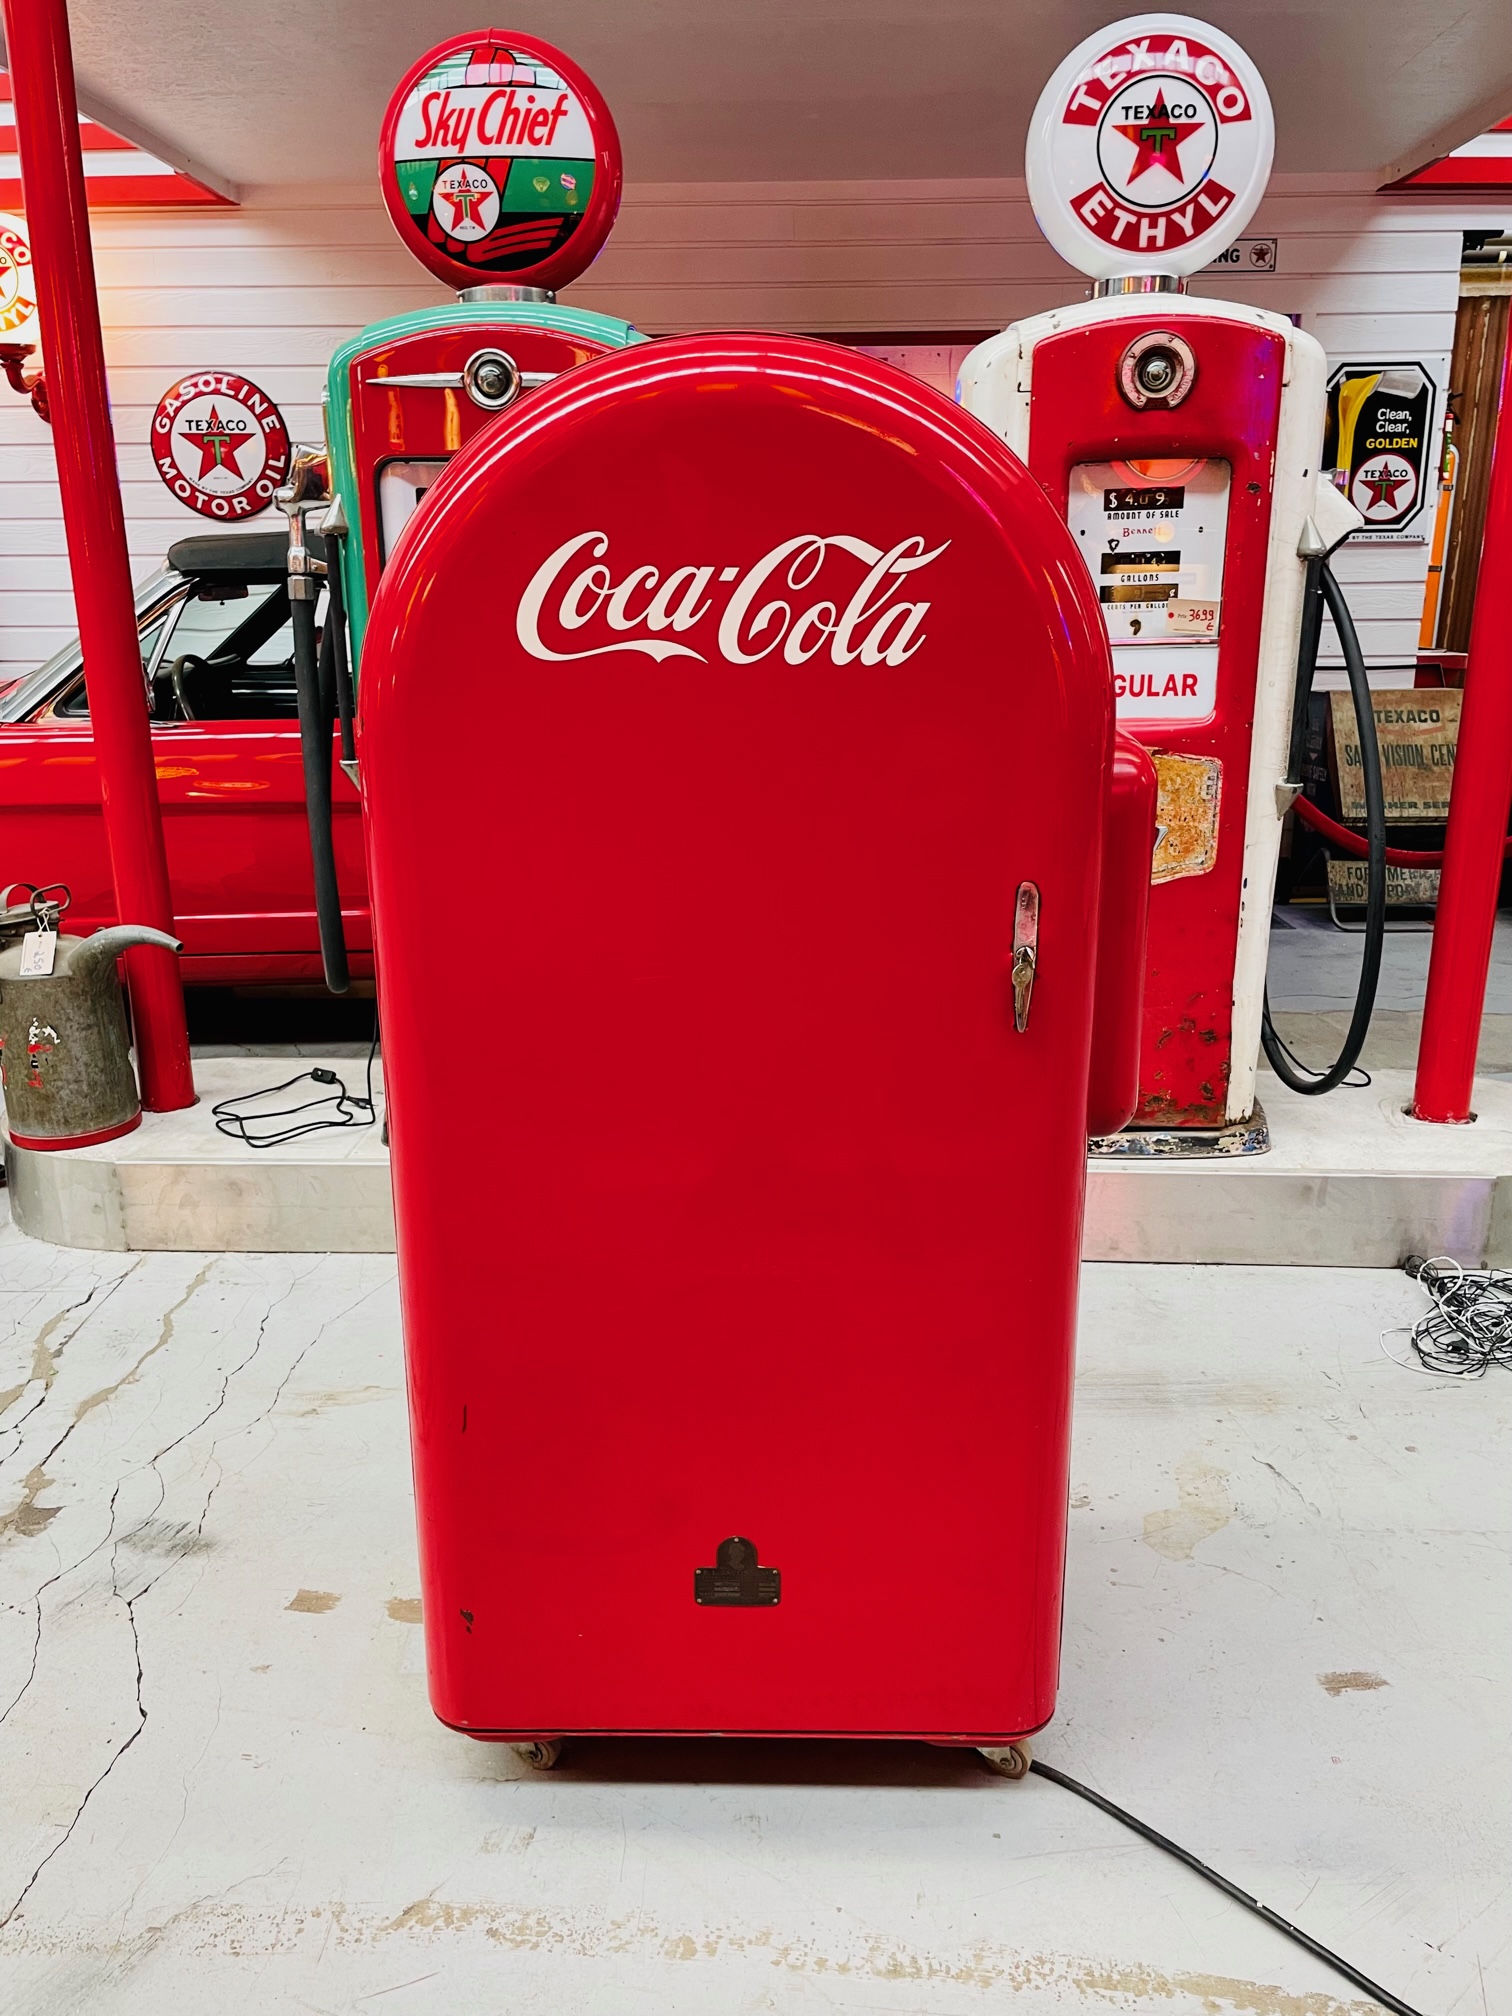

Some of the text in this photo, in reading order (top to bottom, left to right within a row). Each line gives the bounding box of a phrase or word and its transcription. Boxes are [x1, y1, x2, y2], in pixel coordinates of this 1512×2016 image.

[1070, 39, 1245, 118] TEXACO
[1121, 104, 1197, 120] TEXACO
[415, 89, 568, 154] Sky Chief
[442, 179, 488, 189] TEXACO
[1079, 192, 1229, 248] ETHYL
[155, 375, 280, 433] GASOLINE
[1377, 408, 1412, 421] Clean,
[185, 420, 247, 431] TEXACO
[1376, 421, 1409, 434] Clear,
[1366, 438, 1418, 449] GOLDEN
[1363, 469, 1408, 479] TEXACO
[158, 455, 285, 516] MOTOR OIL
[1107, 510, 1179, 520] AMOUNT OF SALE
[1121, 574, 1159, 583] GALLONS
[516, 531, 952, 667] Coca-Cola
[1189, 609, 1214, 622] 3699
[1374, 710, 1440, 723] TEXACO
[1382, 743, 1425, 768] VISION
